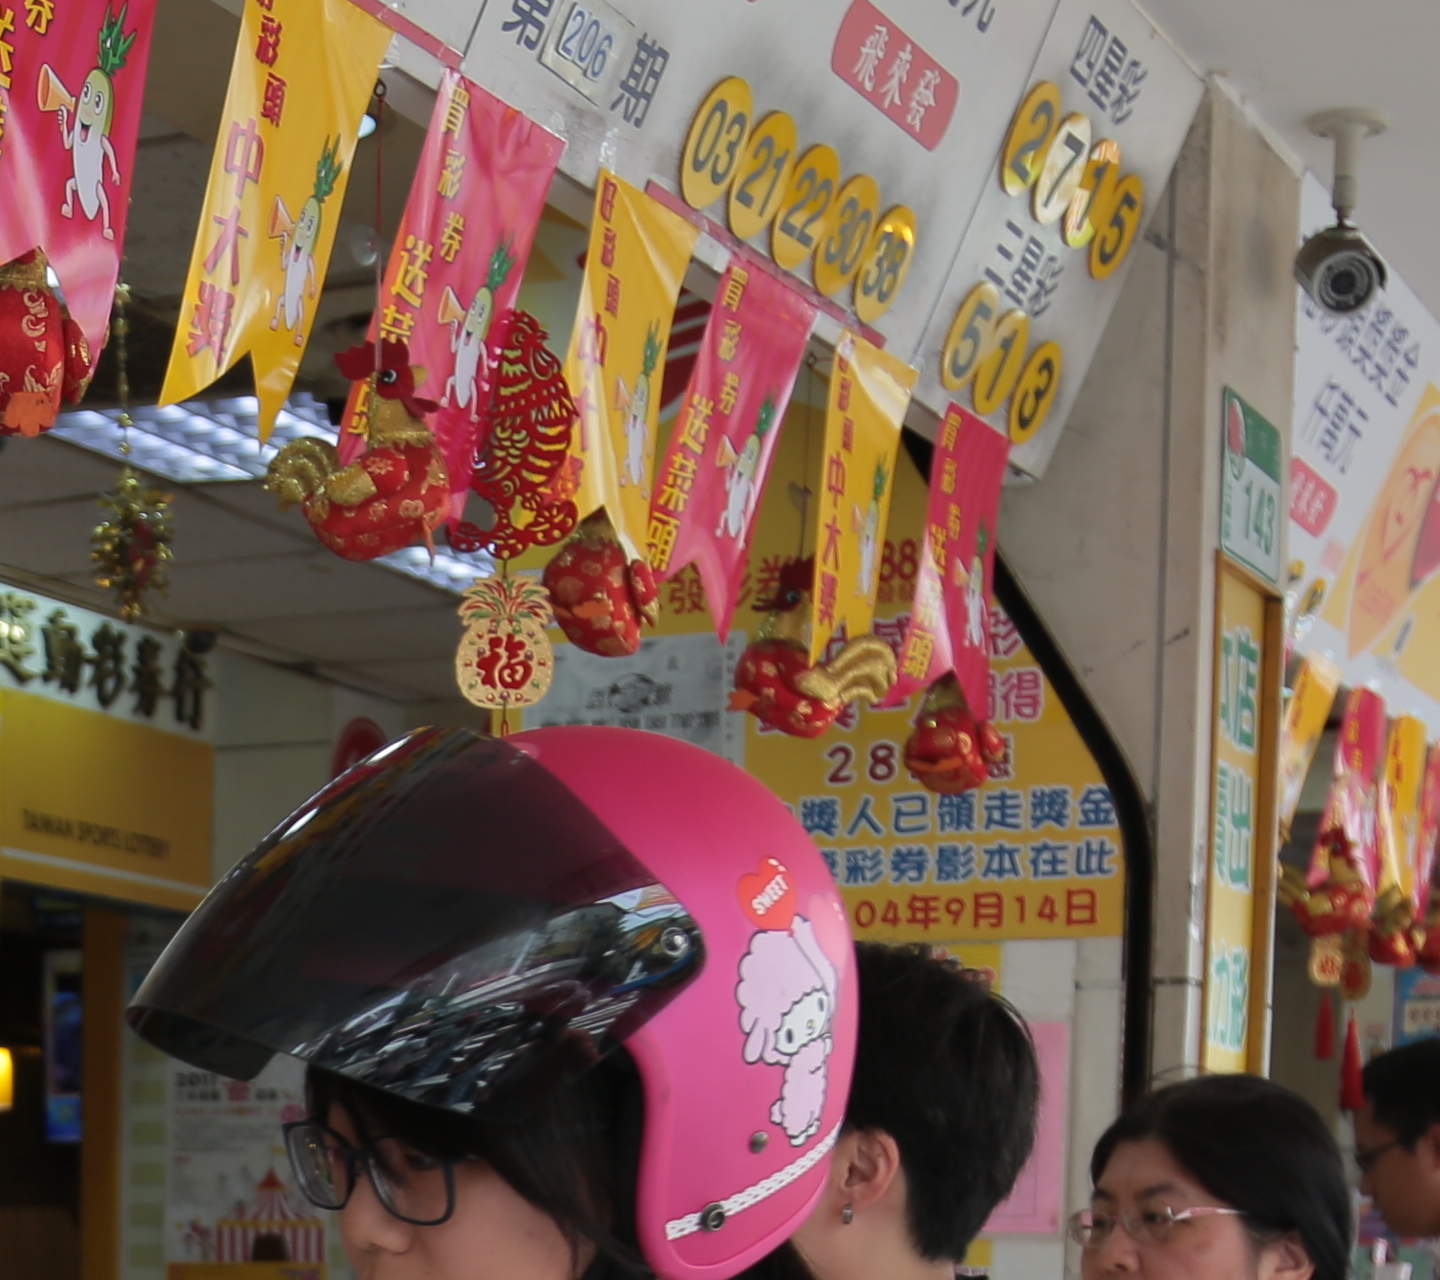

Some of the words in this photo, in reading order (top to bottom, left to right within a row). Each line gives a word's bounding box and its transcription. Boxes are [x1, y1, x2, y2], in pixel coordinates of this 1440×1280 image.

[853, 24, 942, 133] 飛來發
[694, 100, 747, 184] 03
[735, 136, 791, 217] 21
[779, 168, 834, 248] 22
[825, 197, 873, 275] 30
[863, 230, 908, 303] 38
[1011, 100, 1053, 183] 2
[1043, 134, 1085, 207] 7
[1099, 191, 1136, 266] 5
[950, 305, 991, 379] 5
[1021, 357, 1054, 429] 3
[477, 636, 532, 690] 福
[788, 787, 1119, 838] 獎人已領走獎金
[752, 874, 789, 915] SWEET
